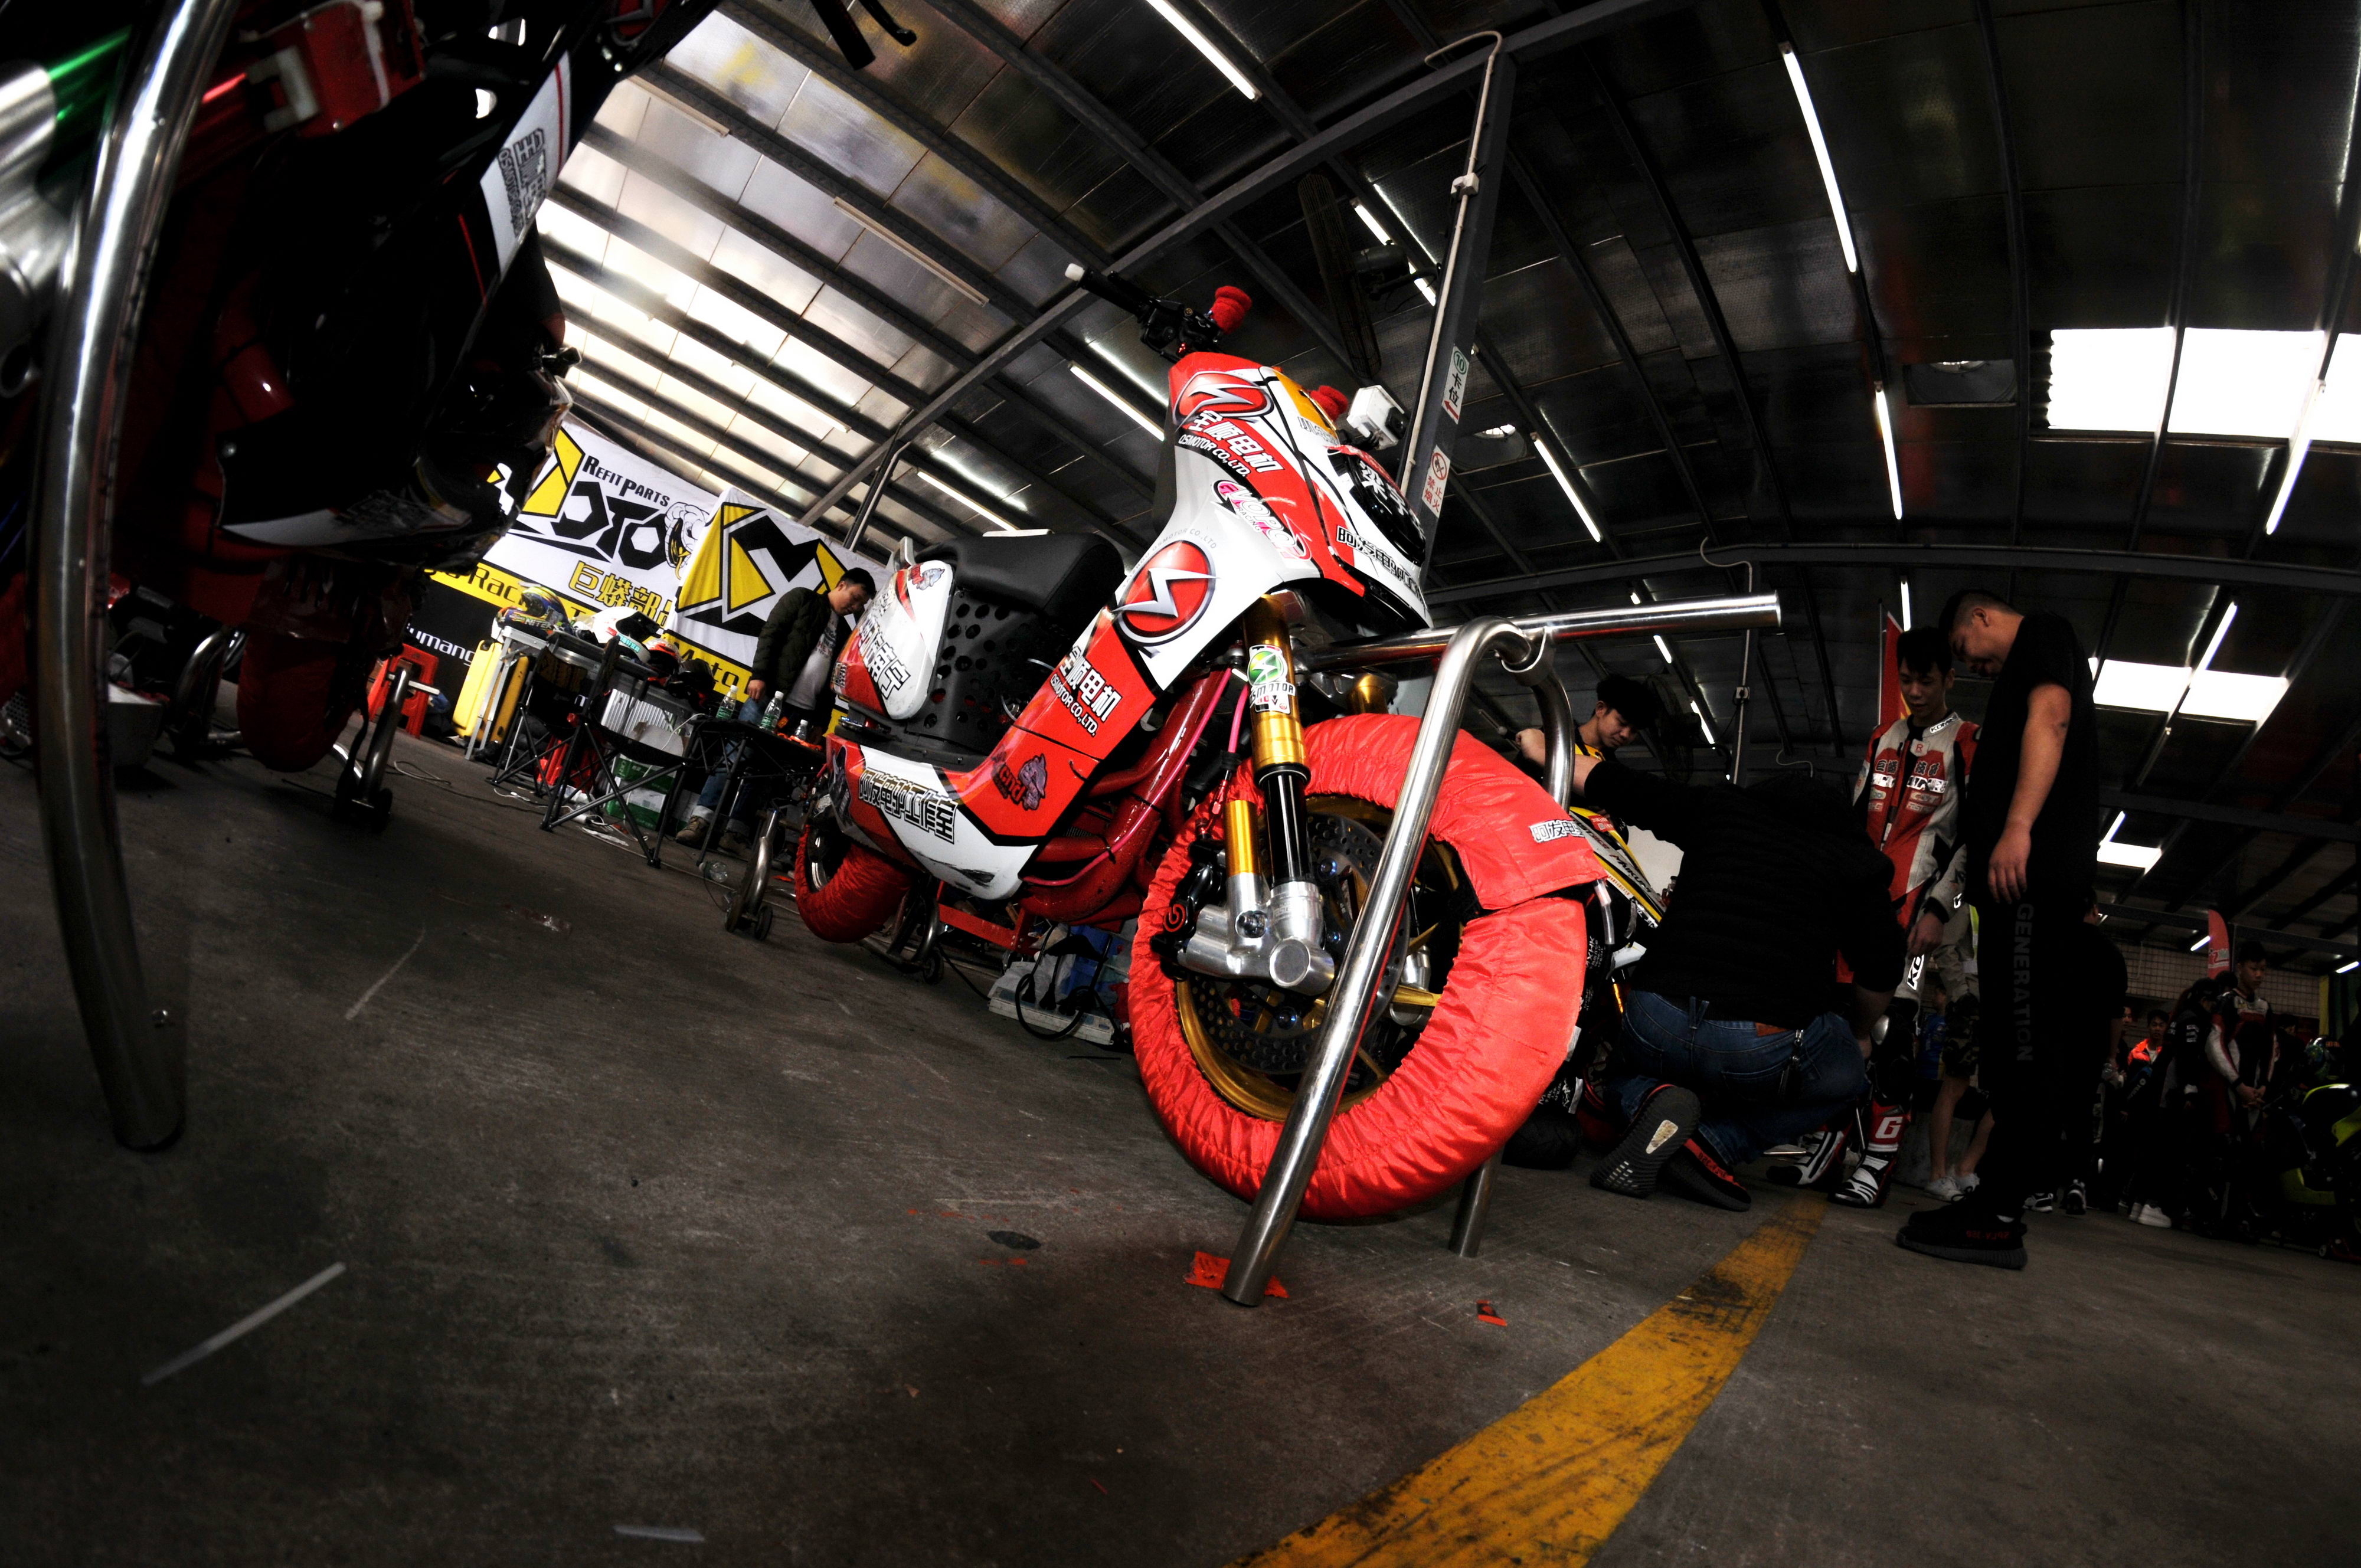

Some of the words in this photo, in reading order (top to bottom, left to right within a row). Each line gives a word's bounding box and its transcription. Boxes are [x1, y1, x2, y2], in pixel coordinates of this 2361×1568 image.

[1448, 372, 1461, 407] 卡位
[1178, 434, 1215, 451] QSMOTOR
[1188, 410, 1285, 473] 全顺电机
[582, 456, 623, 487] REFIT
[619, 479, 671, 507] PARTS
[1426, 475, 1443, 500] 禁止
[1424, 487, 1441, 513] 烟火
[1237, 506, 1261, 531] RACING
[1050, 673, 1074, 708] QSMOTOR
[1059, 646, 1123, 723] 全顺电机
[2013, 903, 2035, 1062] GENERATION
[1874, 1116, 1904, 1139] G
